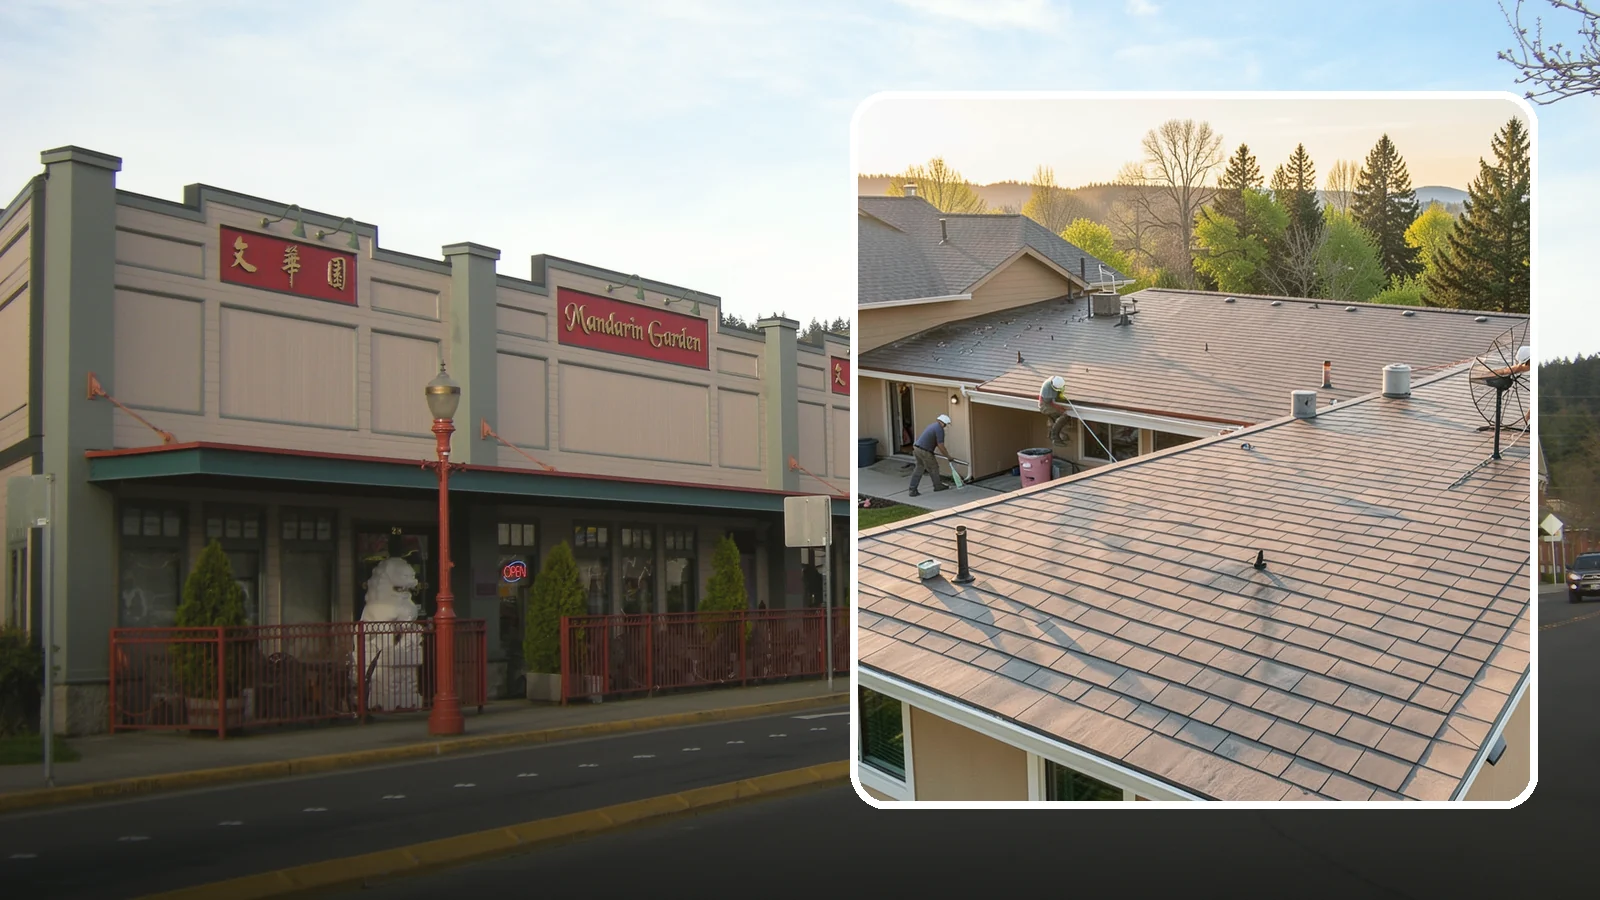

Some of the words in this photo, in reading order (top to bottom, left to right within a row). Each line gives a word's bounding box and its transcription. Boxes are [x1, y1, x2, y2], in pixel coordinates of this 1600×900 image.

[231, 236, 346, 291] 文華園
[564, 302, 644, 341] Mandarin
[648, 320, 702, 352] Garden
[503, 565, 527, 578] OPEN
